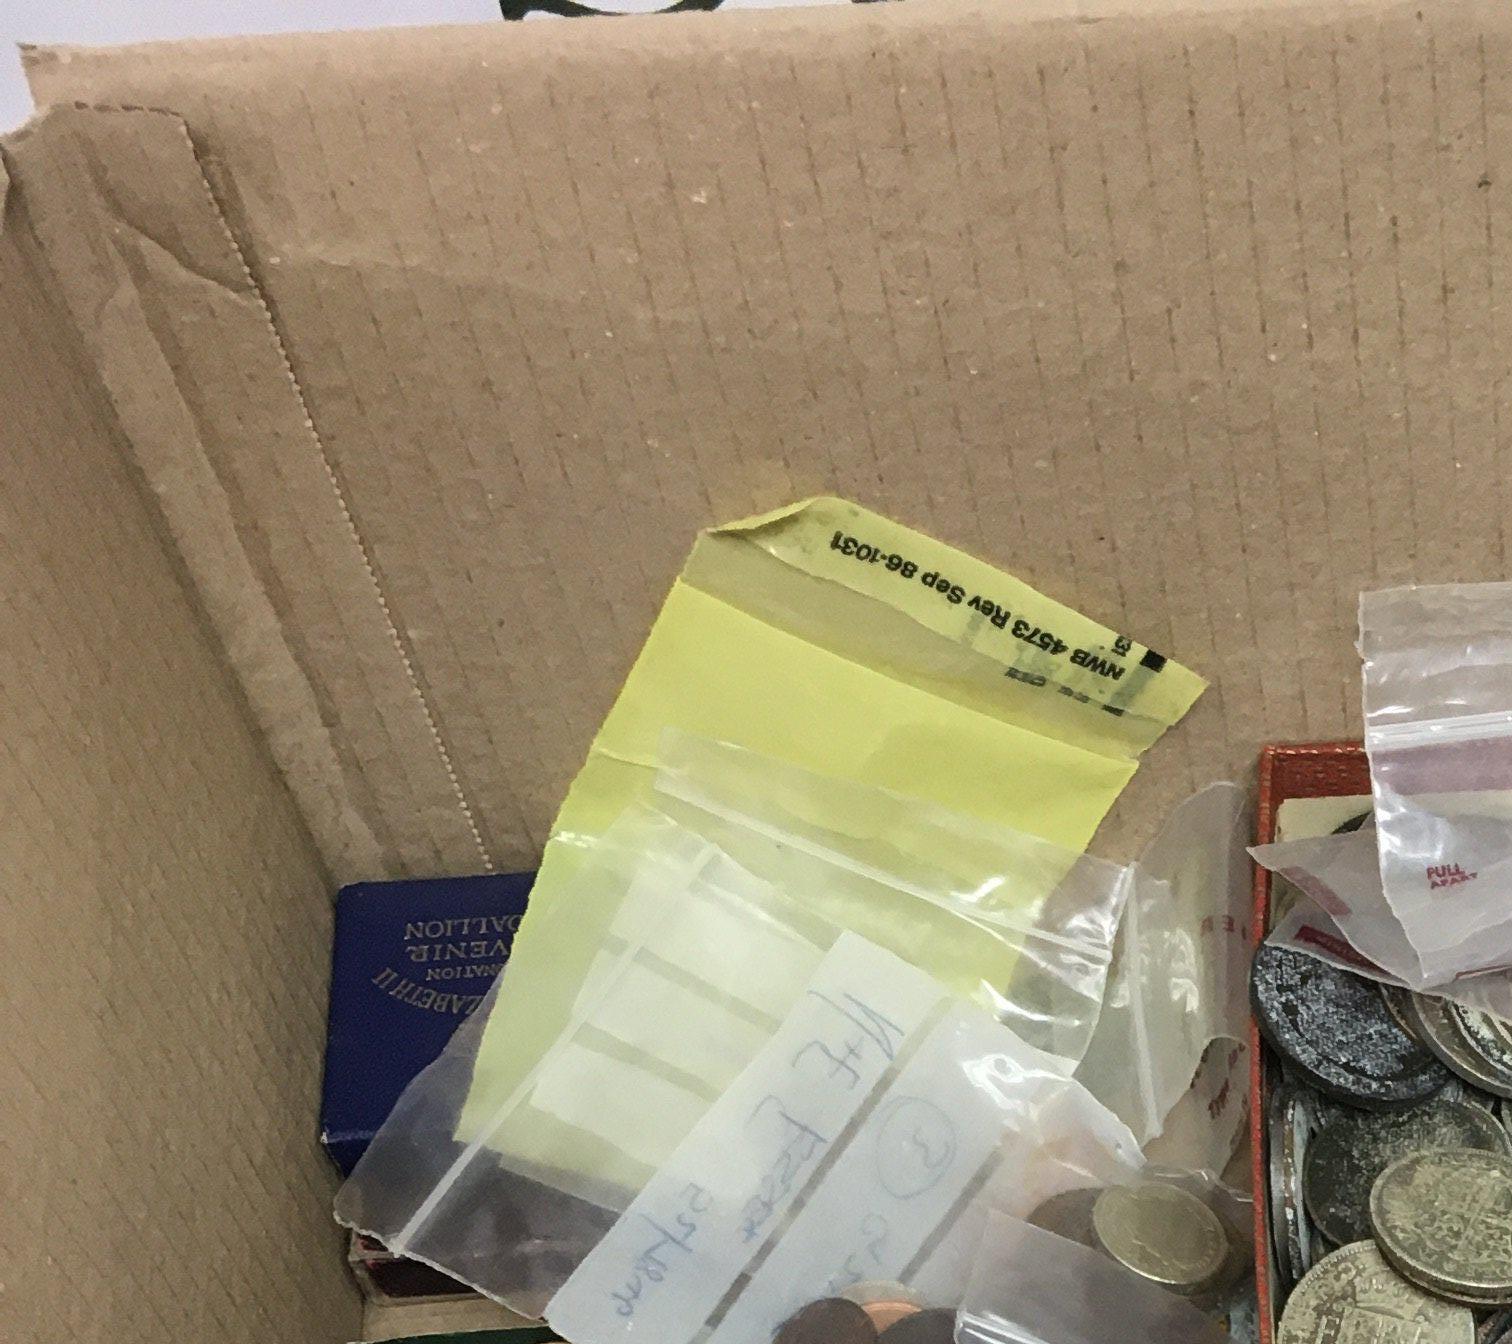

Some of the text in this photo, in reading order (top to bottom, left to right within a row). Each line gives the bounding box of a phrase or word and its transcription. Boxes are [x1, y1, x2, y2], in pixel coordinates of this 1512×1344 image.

[829, 530, 918, 579] 86-1031
[919, 570, 968, 605] Sep
[967, 594, 1012, 630] Rev
[1011, 619, 1069, 655] 4573
[1069, 646, 1125, 681] NWB
